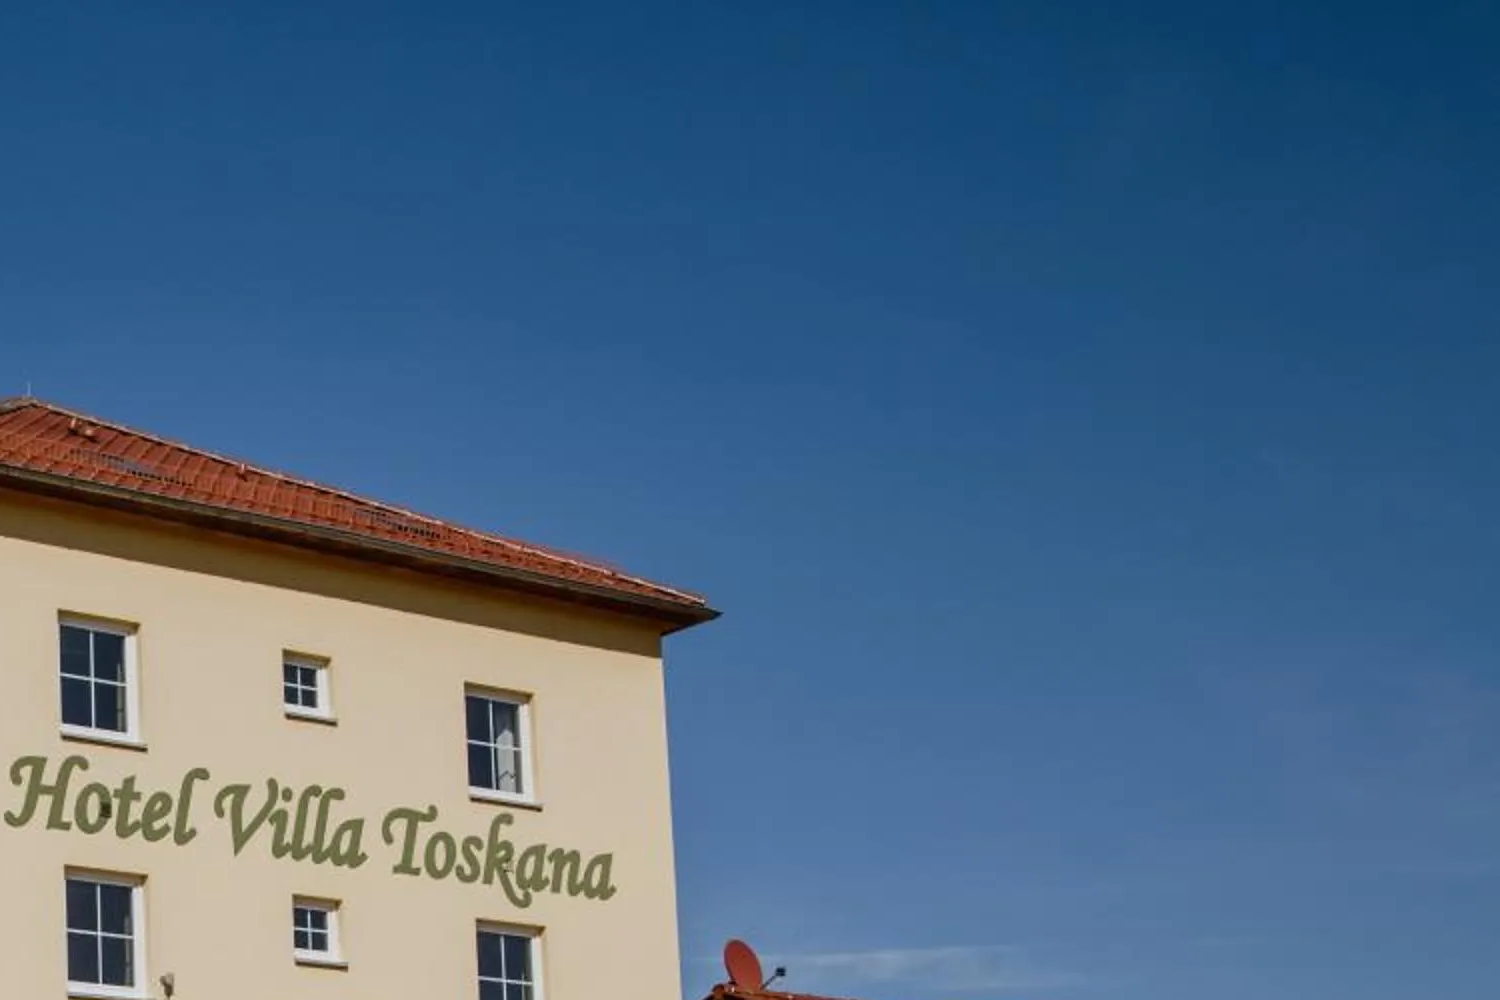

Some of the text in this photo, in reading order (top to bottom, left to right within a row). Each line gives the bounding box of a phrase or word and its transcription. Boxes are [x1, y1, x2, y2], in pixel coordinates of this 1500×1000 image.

[4, 755, 617, 908] Hotel Villa Toskana
